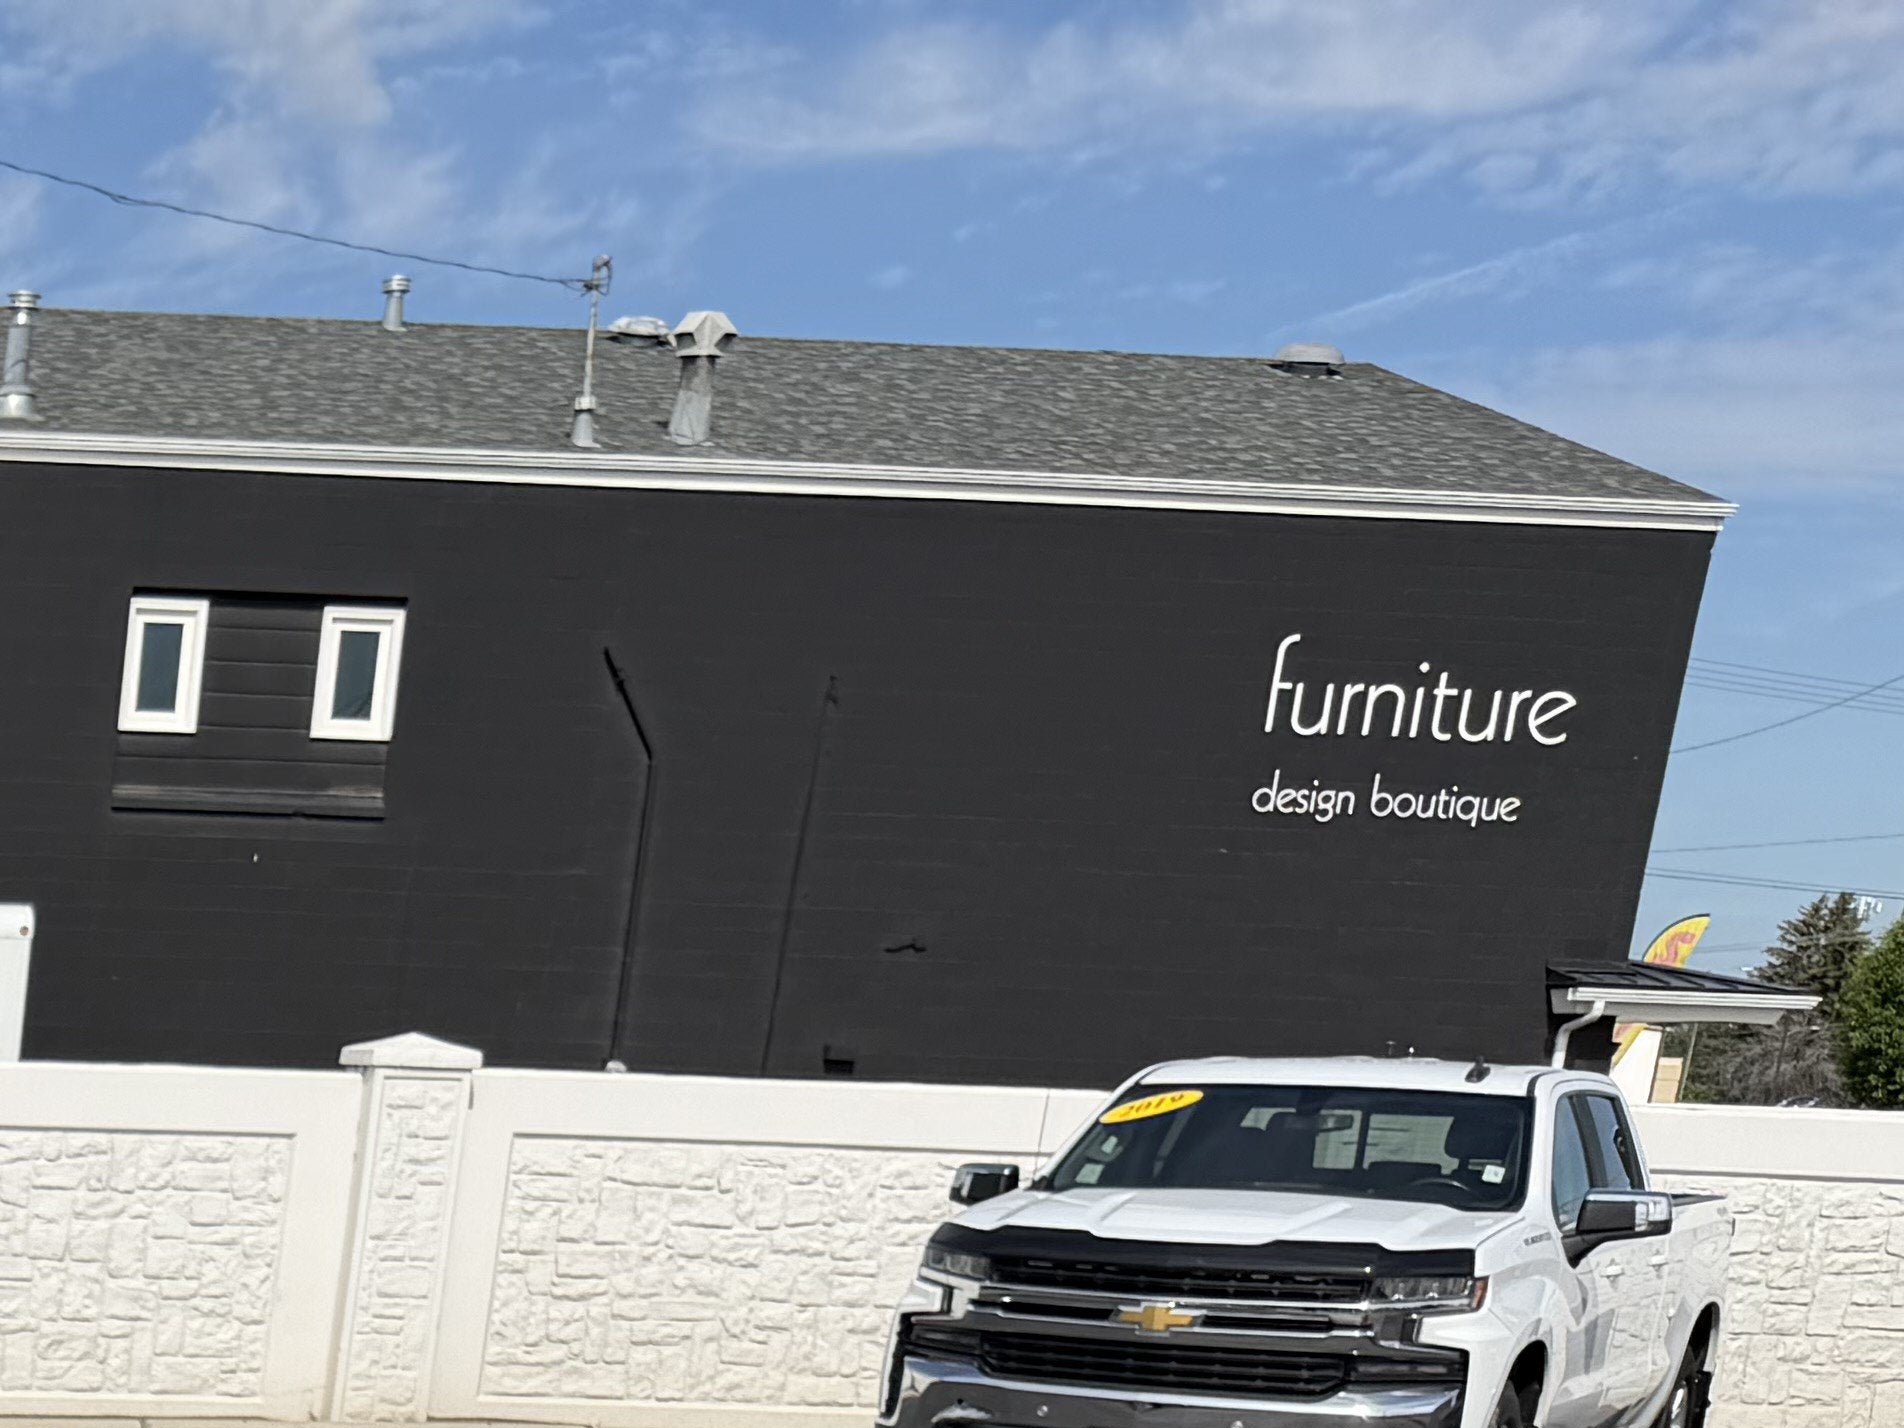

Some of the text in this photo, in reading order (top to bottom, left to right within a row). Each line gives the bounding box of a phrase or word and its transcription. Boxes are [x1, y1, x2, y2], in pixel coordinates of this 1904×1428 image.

[1264, 633, 1577, 746] furniture
[1251, 768, 1522, 828] design boutique
